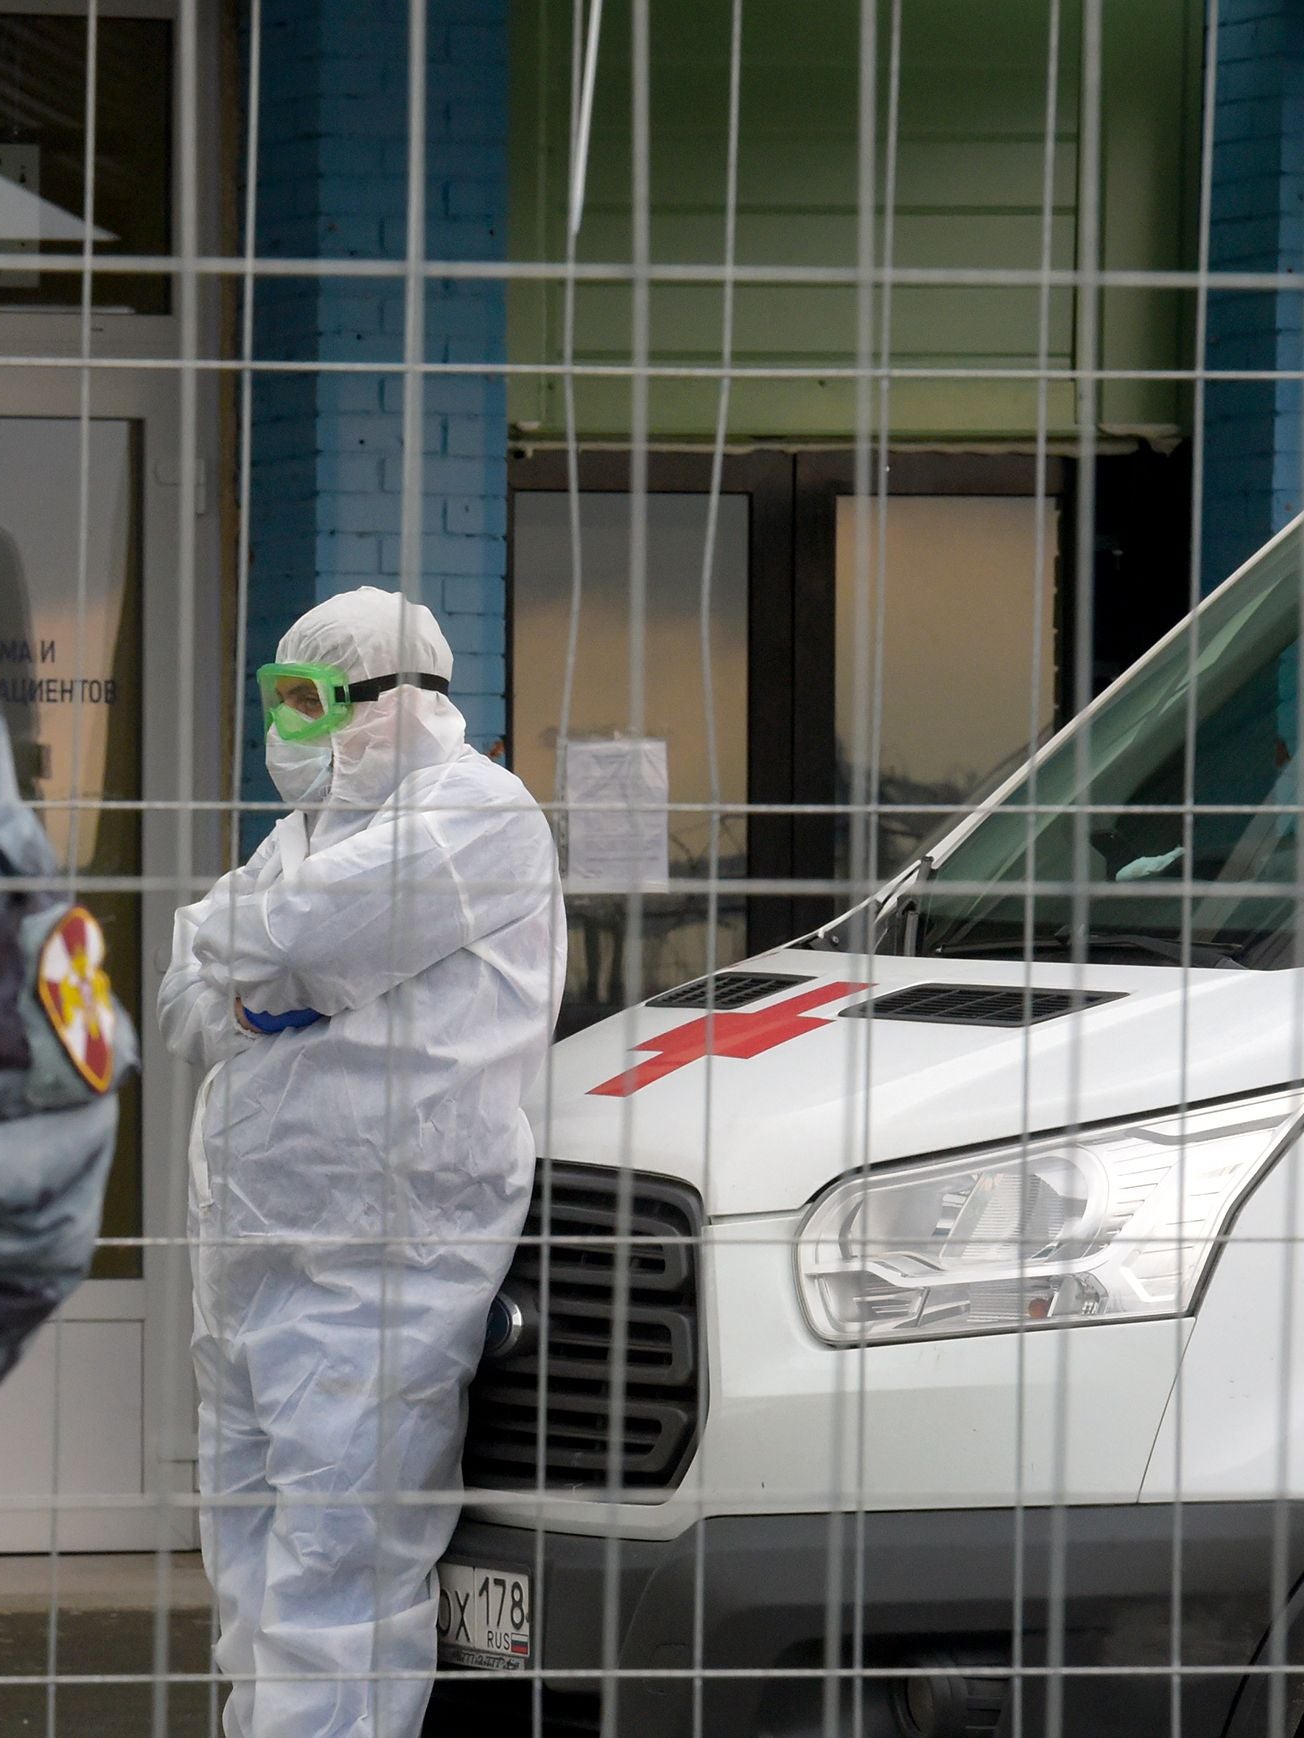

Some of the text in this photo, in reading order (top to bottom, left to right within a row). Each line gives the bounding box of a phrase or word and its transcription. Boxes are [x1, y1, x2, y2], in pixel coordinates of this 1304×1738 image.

[40, 640, 55, 663] И
[478, 1576, 525, 1631] 178
[486, 1630, 511, 1651] RUS
